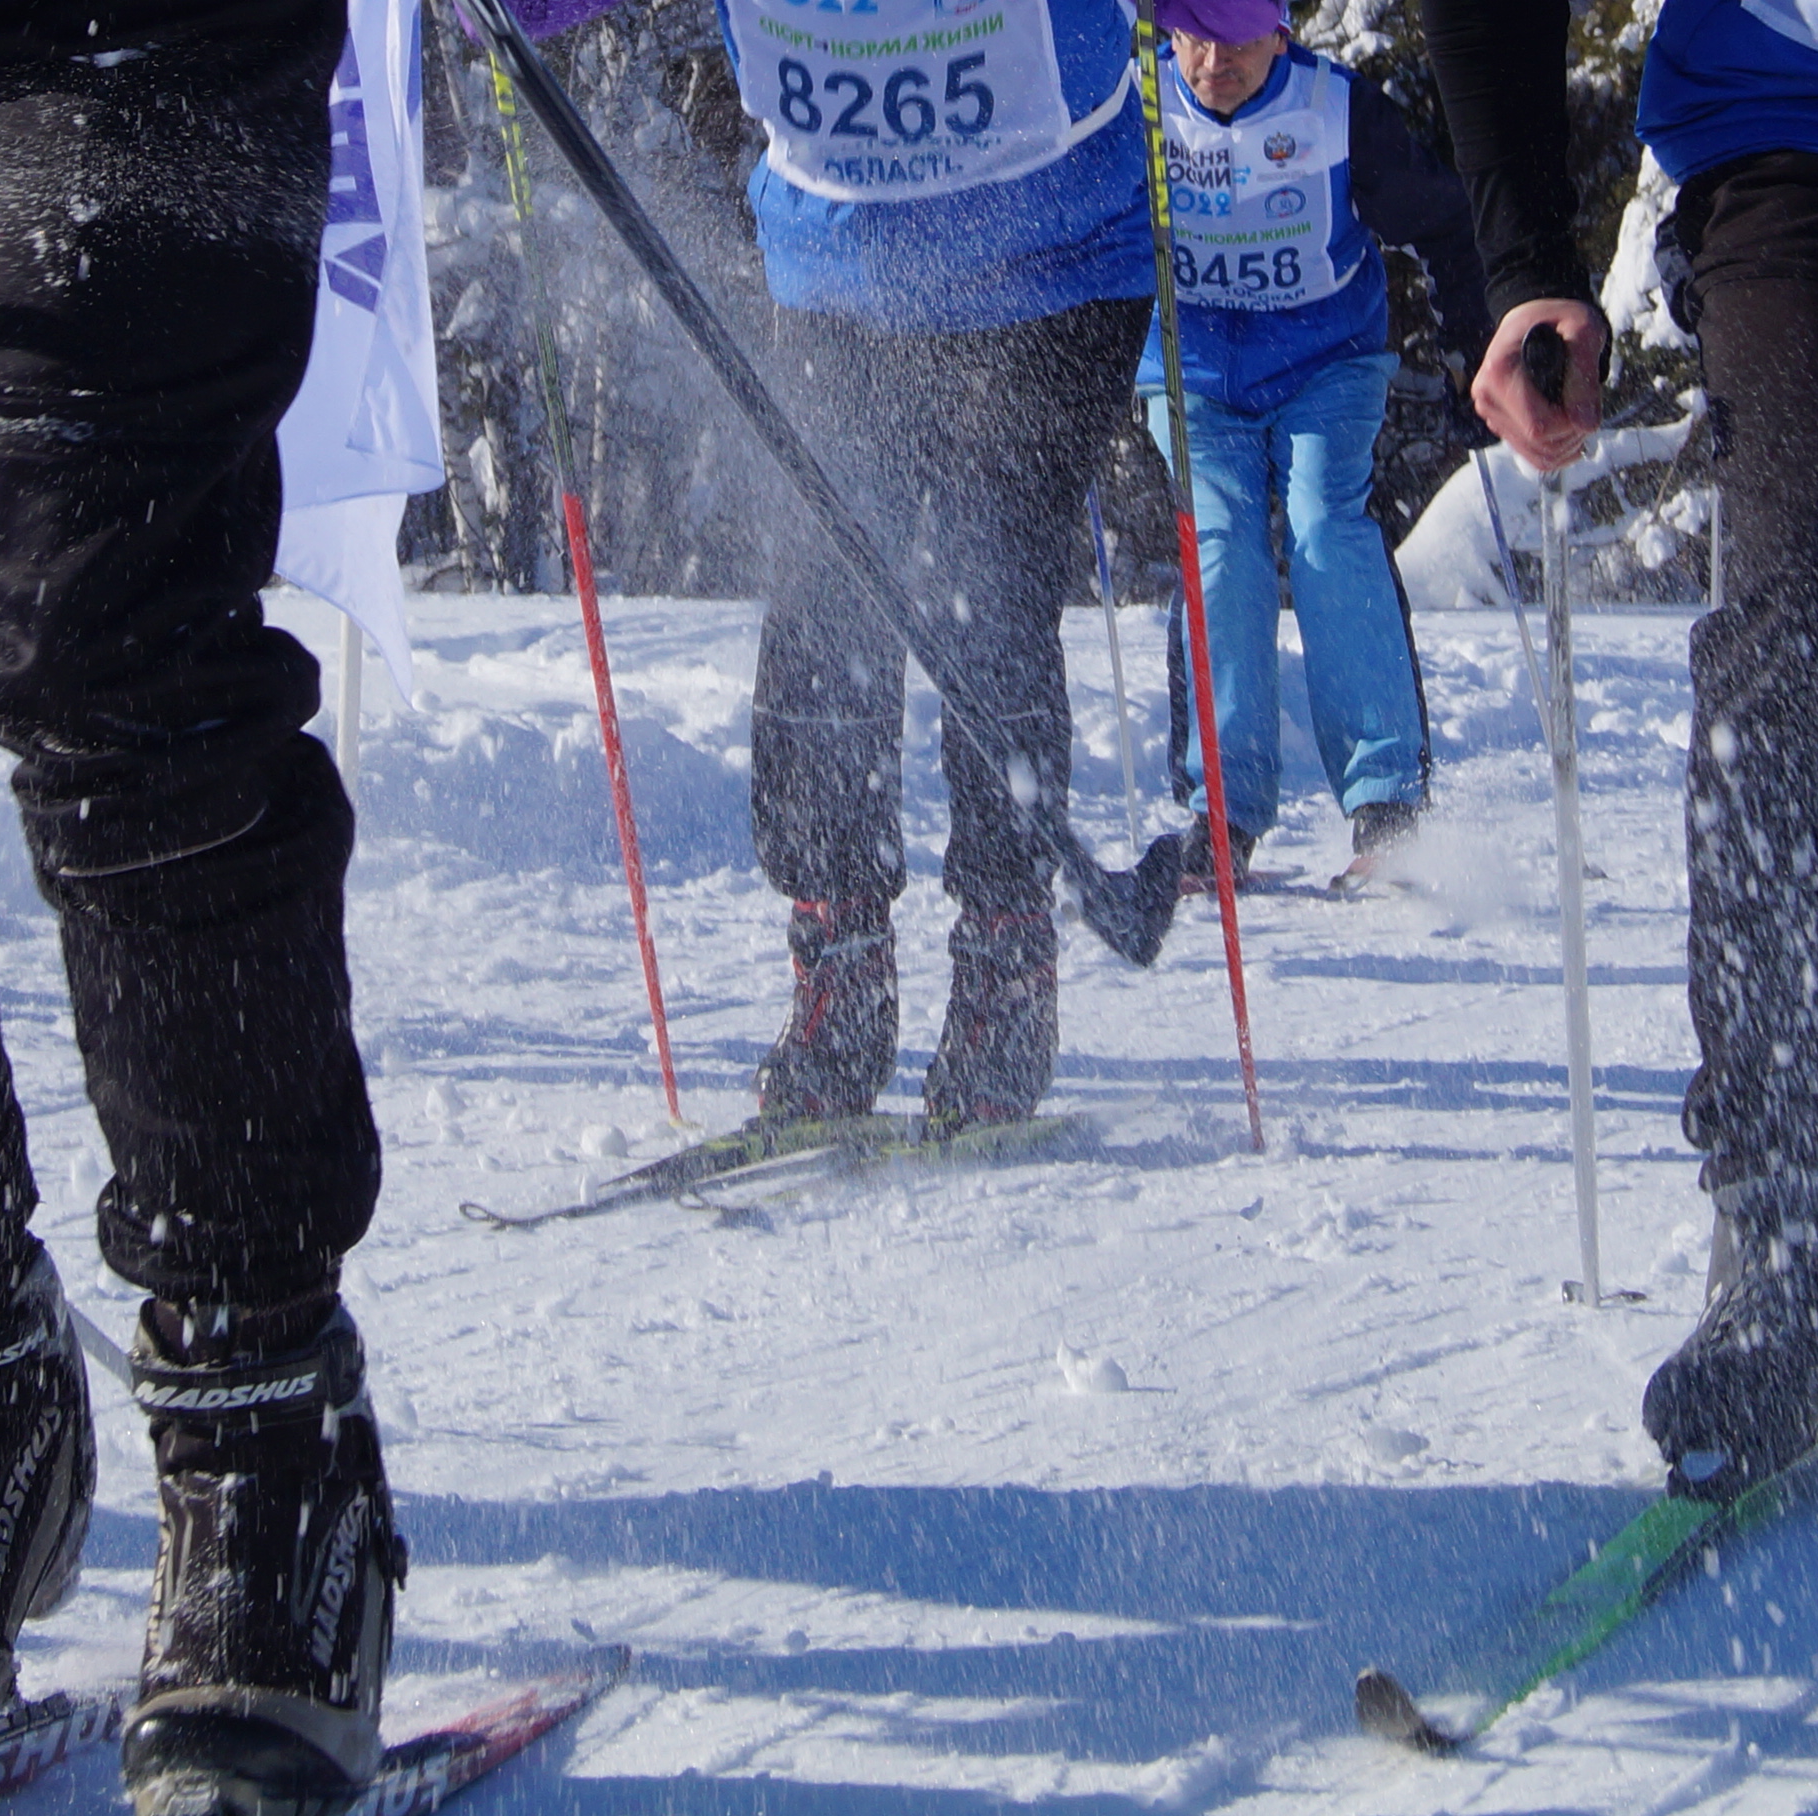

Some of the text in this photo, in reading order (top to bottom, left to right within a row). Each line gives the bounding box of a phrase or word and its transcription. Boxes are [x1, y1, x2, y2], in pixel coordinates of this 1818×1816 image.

[831, 33, 918, 60] НОРМА
[922, 11, 1004, 53] ЖИЗНИ
[778, 49, 994, 141] 8265
[1170, 187, 1232, 217] 022
[1174, 244, 1302, 291] 8458
[132, 1371, 318, 1410] MADSHUS
